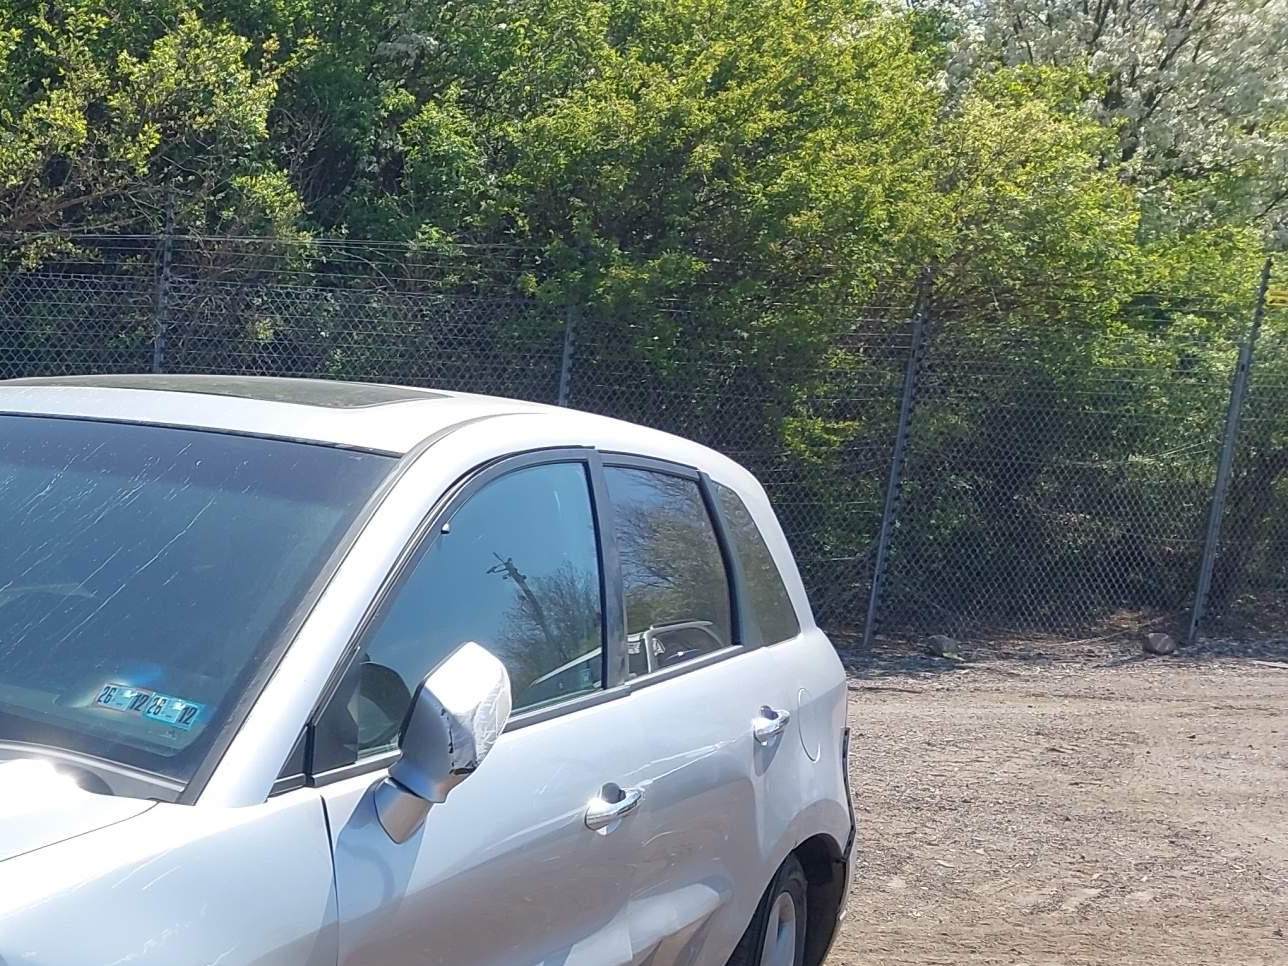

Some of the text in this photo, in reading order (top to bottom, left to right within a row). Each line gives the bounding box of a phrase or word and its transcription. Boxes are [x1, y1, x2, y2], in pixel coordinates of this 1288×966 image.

[97, 686, 150, 712] 26 12
[147, 697, 198, 725] 26 12
